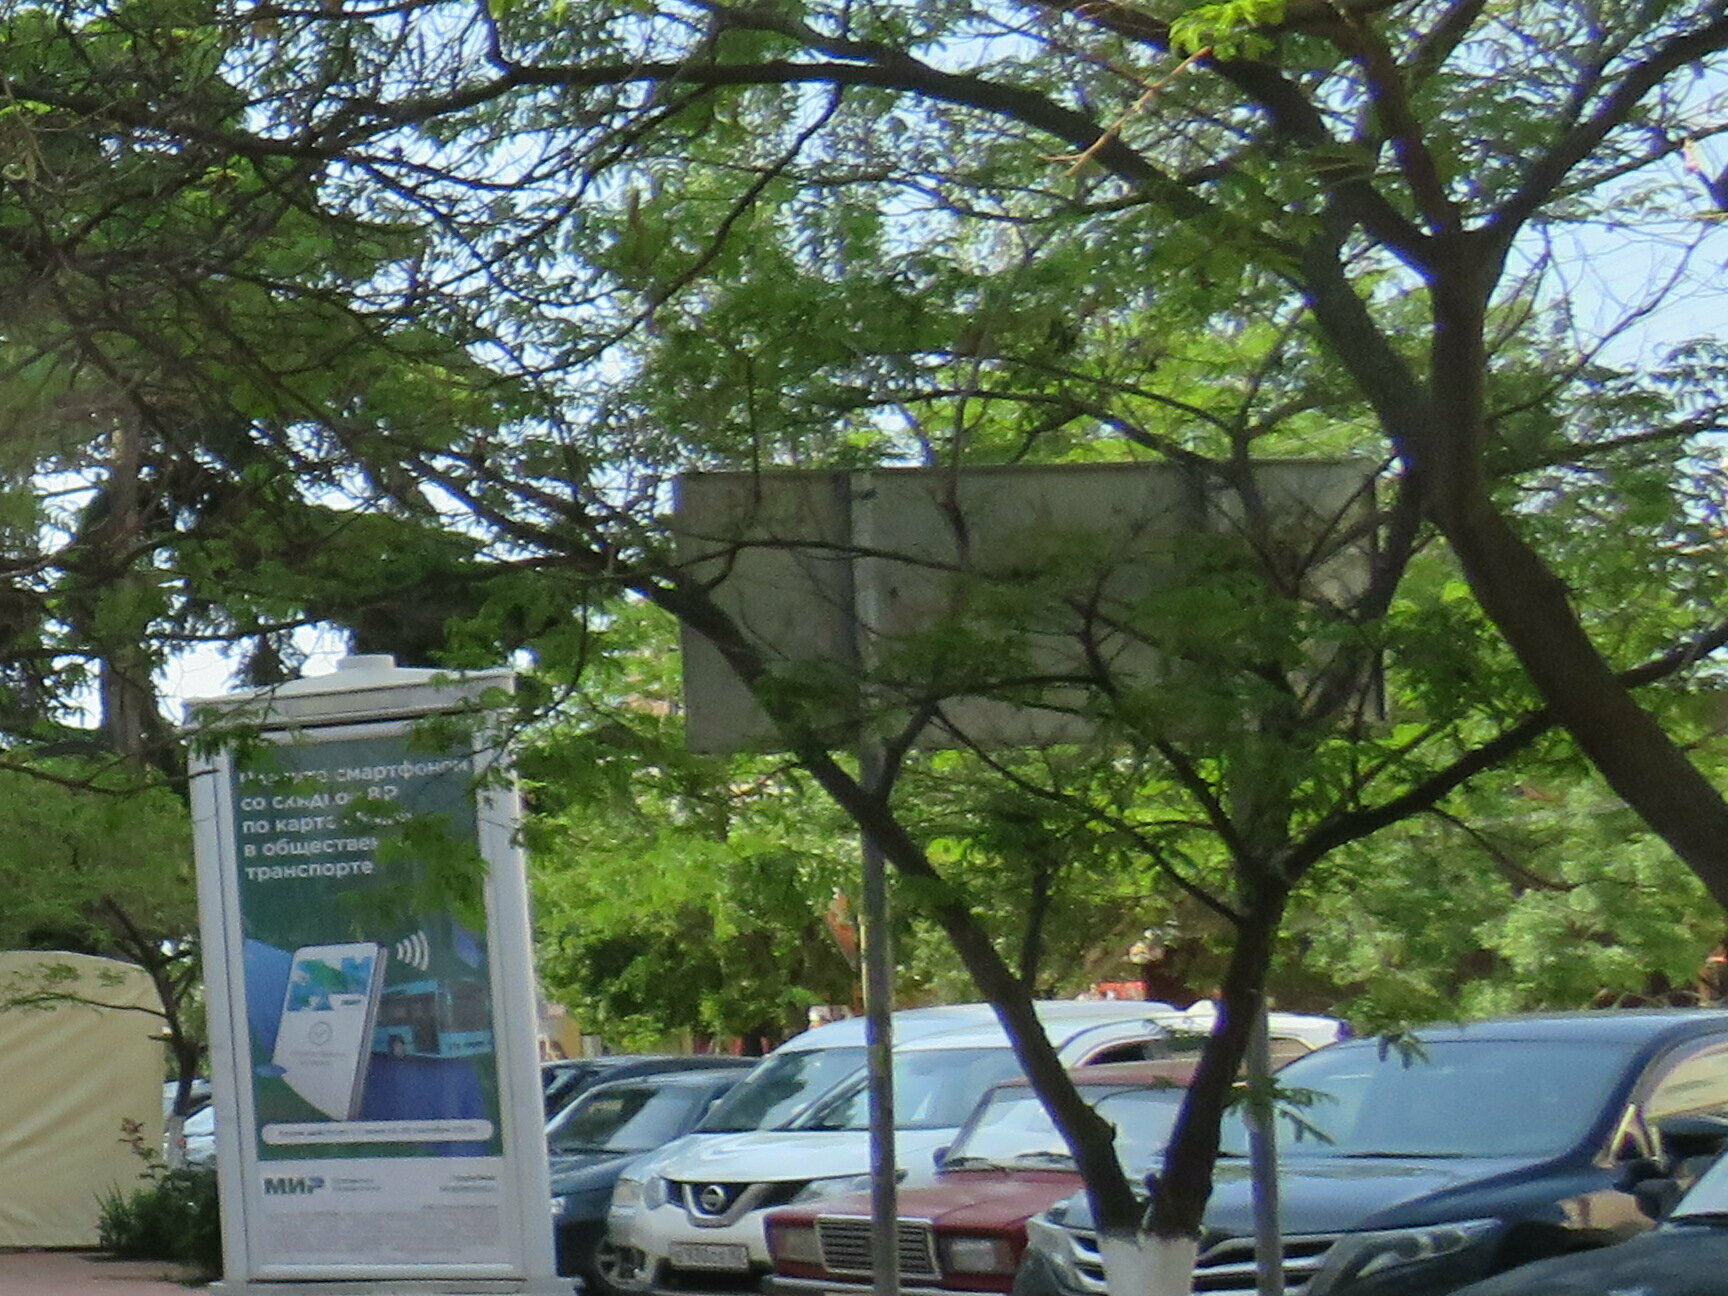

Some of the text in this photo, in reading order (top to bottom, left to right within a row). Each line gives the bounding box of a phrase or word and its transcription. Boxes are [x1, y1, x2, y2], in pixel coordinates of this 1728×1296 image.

[240, 796, 266, 811] со
[242, 819, 270, 834] по
[275, 815, 337, 835] карте
[244, 843, 257, 858] в
[244, 859, 375, 883] транспорте
[263, 1176, 325, 1195] МИР
